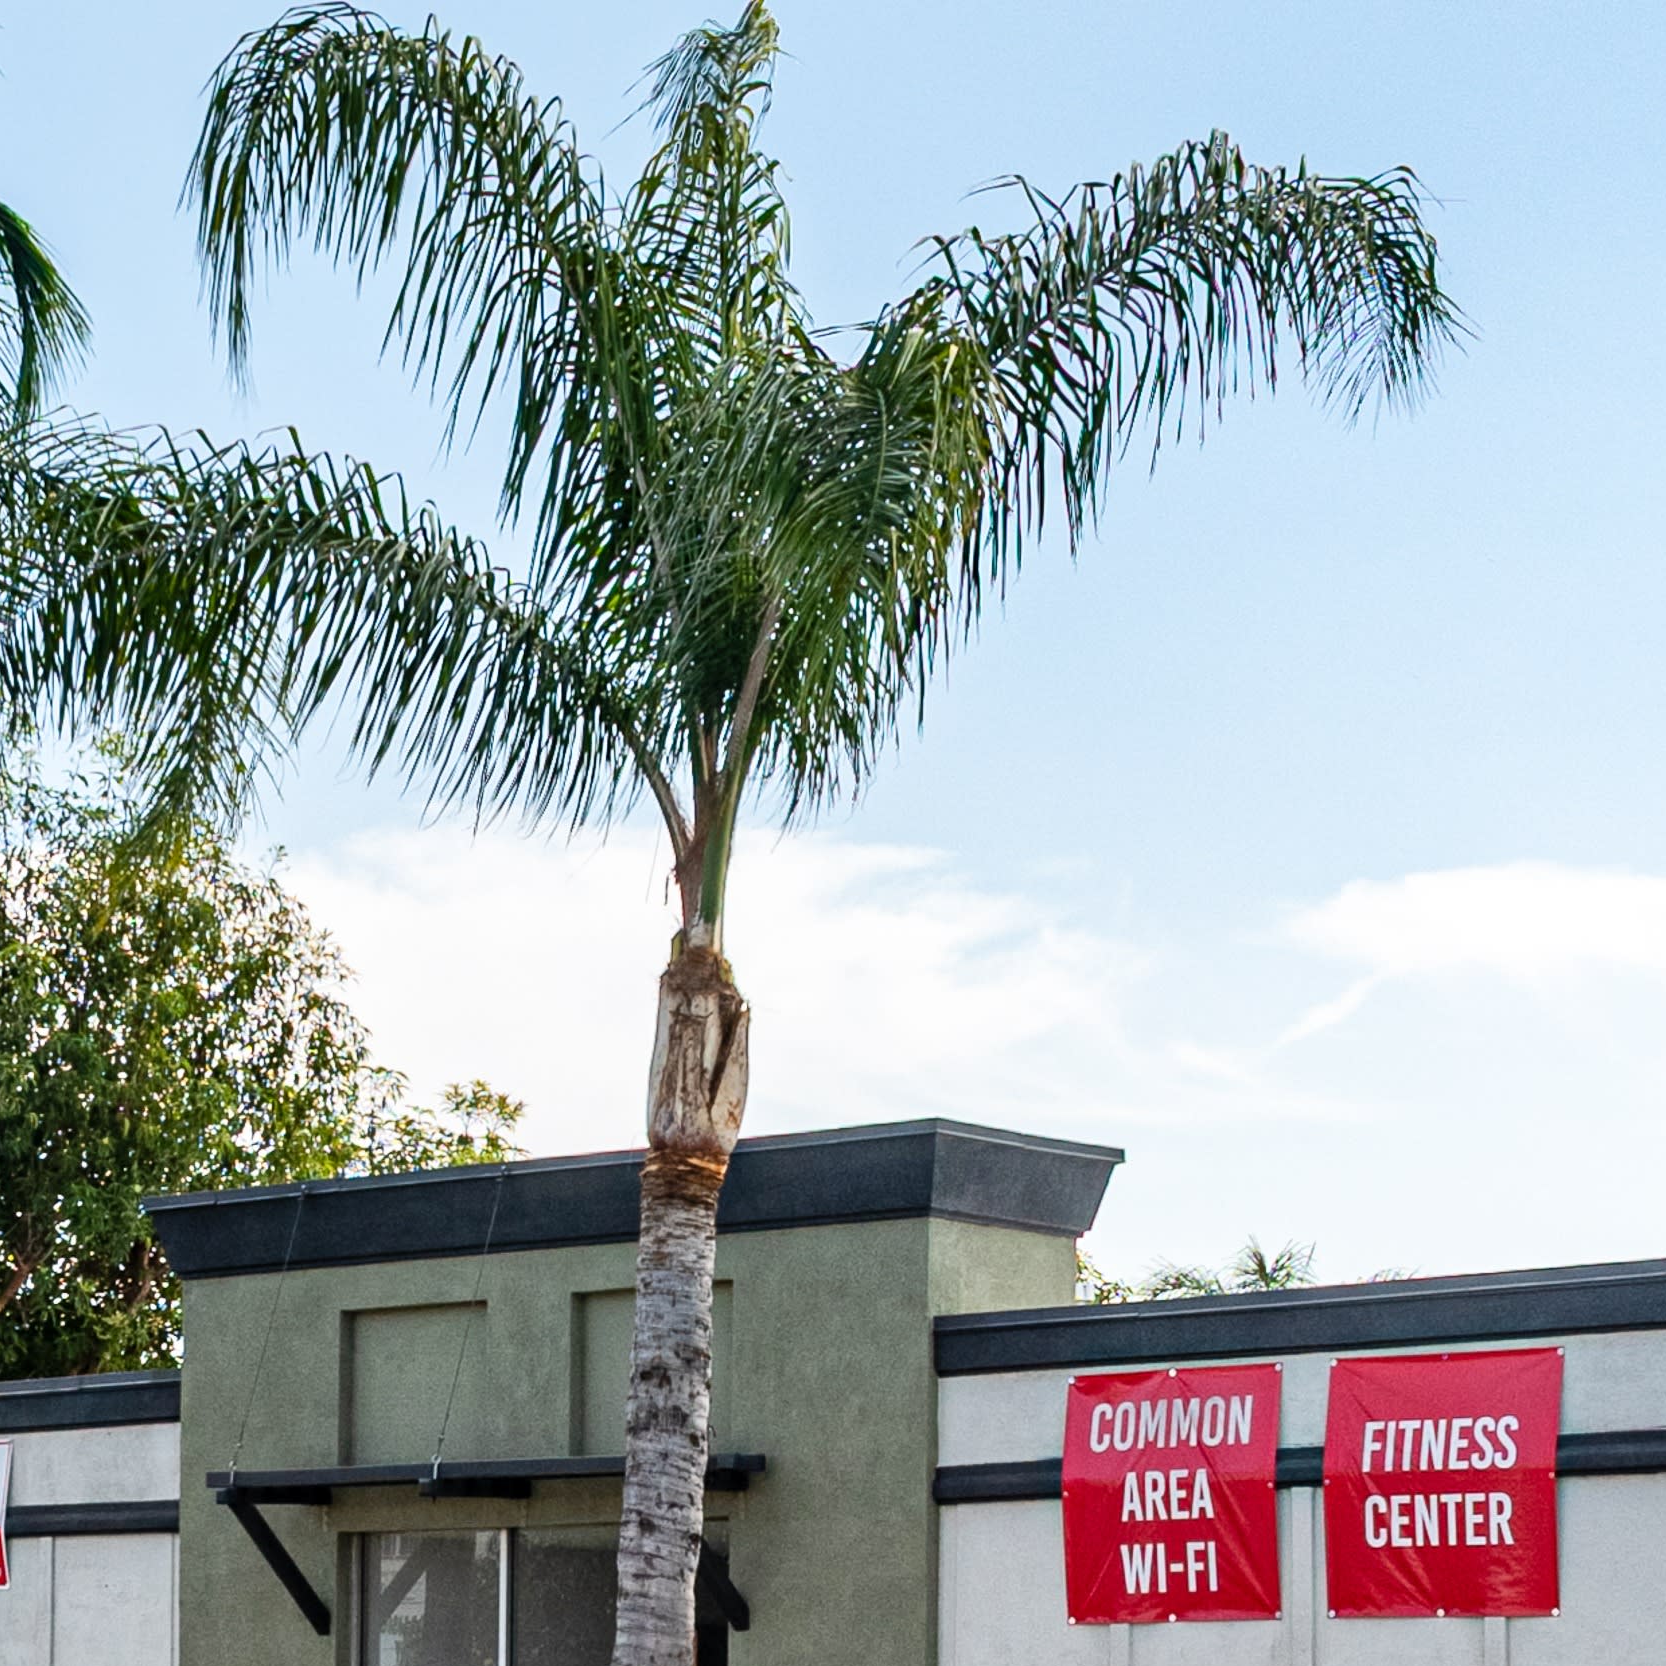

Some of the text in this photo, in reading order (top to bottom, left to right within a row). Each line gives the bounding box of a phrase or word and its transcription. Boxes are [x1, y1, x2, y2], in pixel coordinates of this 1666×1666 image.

[1089, 1394, 1253, 1453] COMMON
[1361, 1415, 1520, 1473] FITNESS
[1121, 1469, 1215, 1522] AREA
[1364, 1492, 1515, 1549] CENTER
[1121, 1541, 1219, 1594] WI-FI
